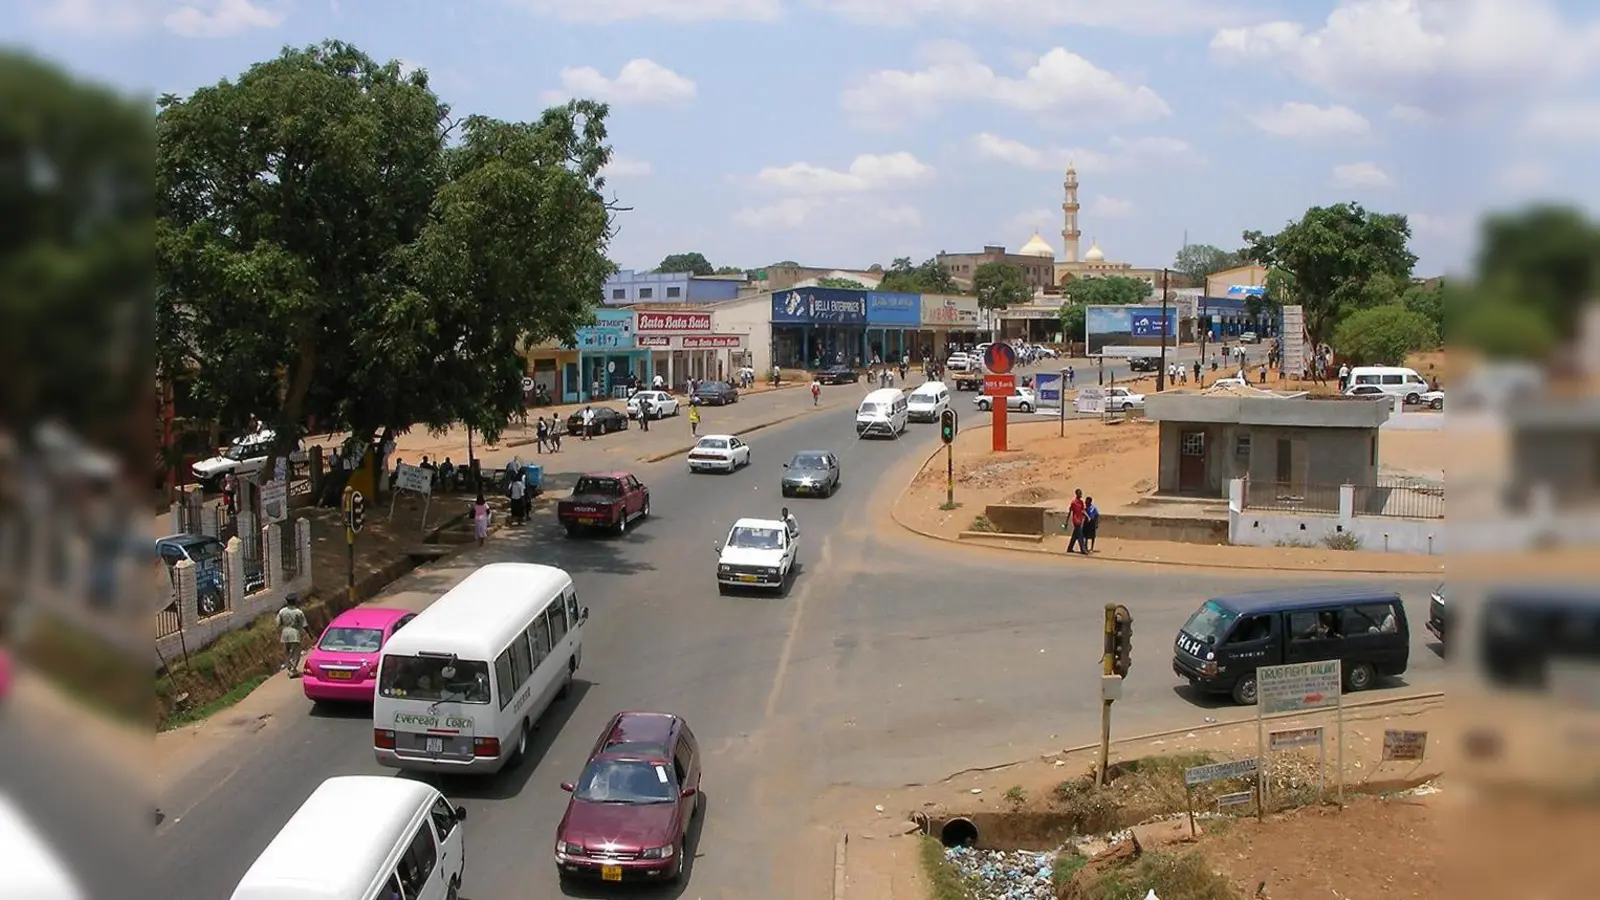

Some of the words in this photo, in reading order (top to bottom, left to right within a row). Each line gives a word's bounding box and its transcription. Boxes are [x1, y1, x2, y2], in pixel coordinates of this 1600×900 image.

[815, 299, 830, 312] BELLA
[640, 314, 664, 330] Bata
[664, 314, 687, 329] Bata
[687, 315, 710, 329] Bata
[641, 336, 667, 345] Bata
[1261, 666, 1283, 680] DRUG
[1284, 664, 1309, 678] FIGHT
[395, 713, 439, 727] Eveready
[446, 716, 473, 729] Coach
